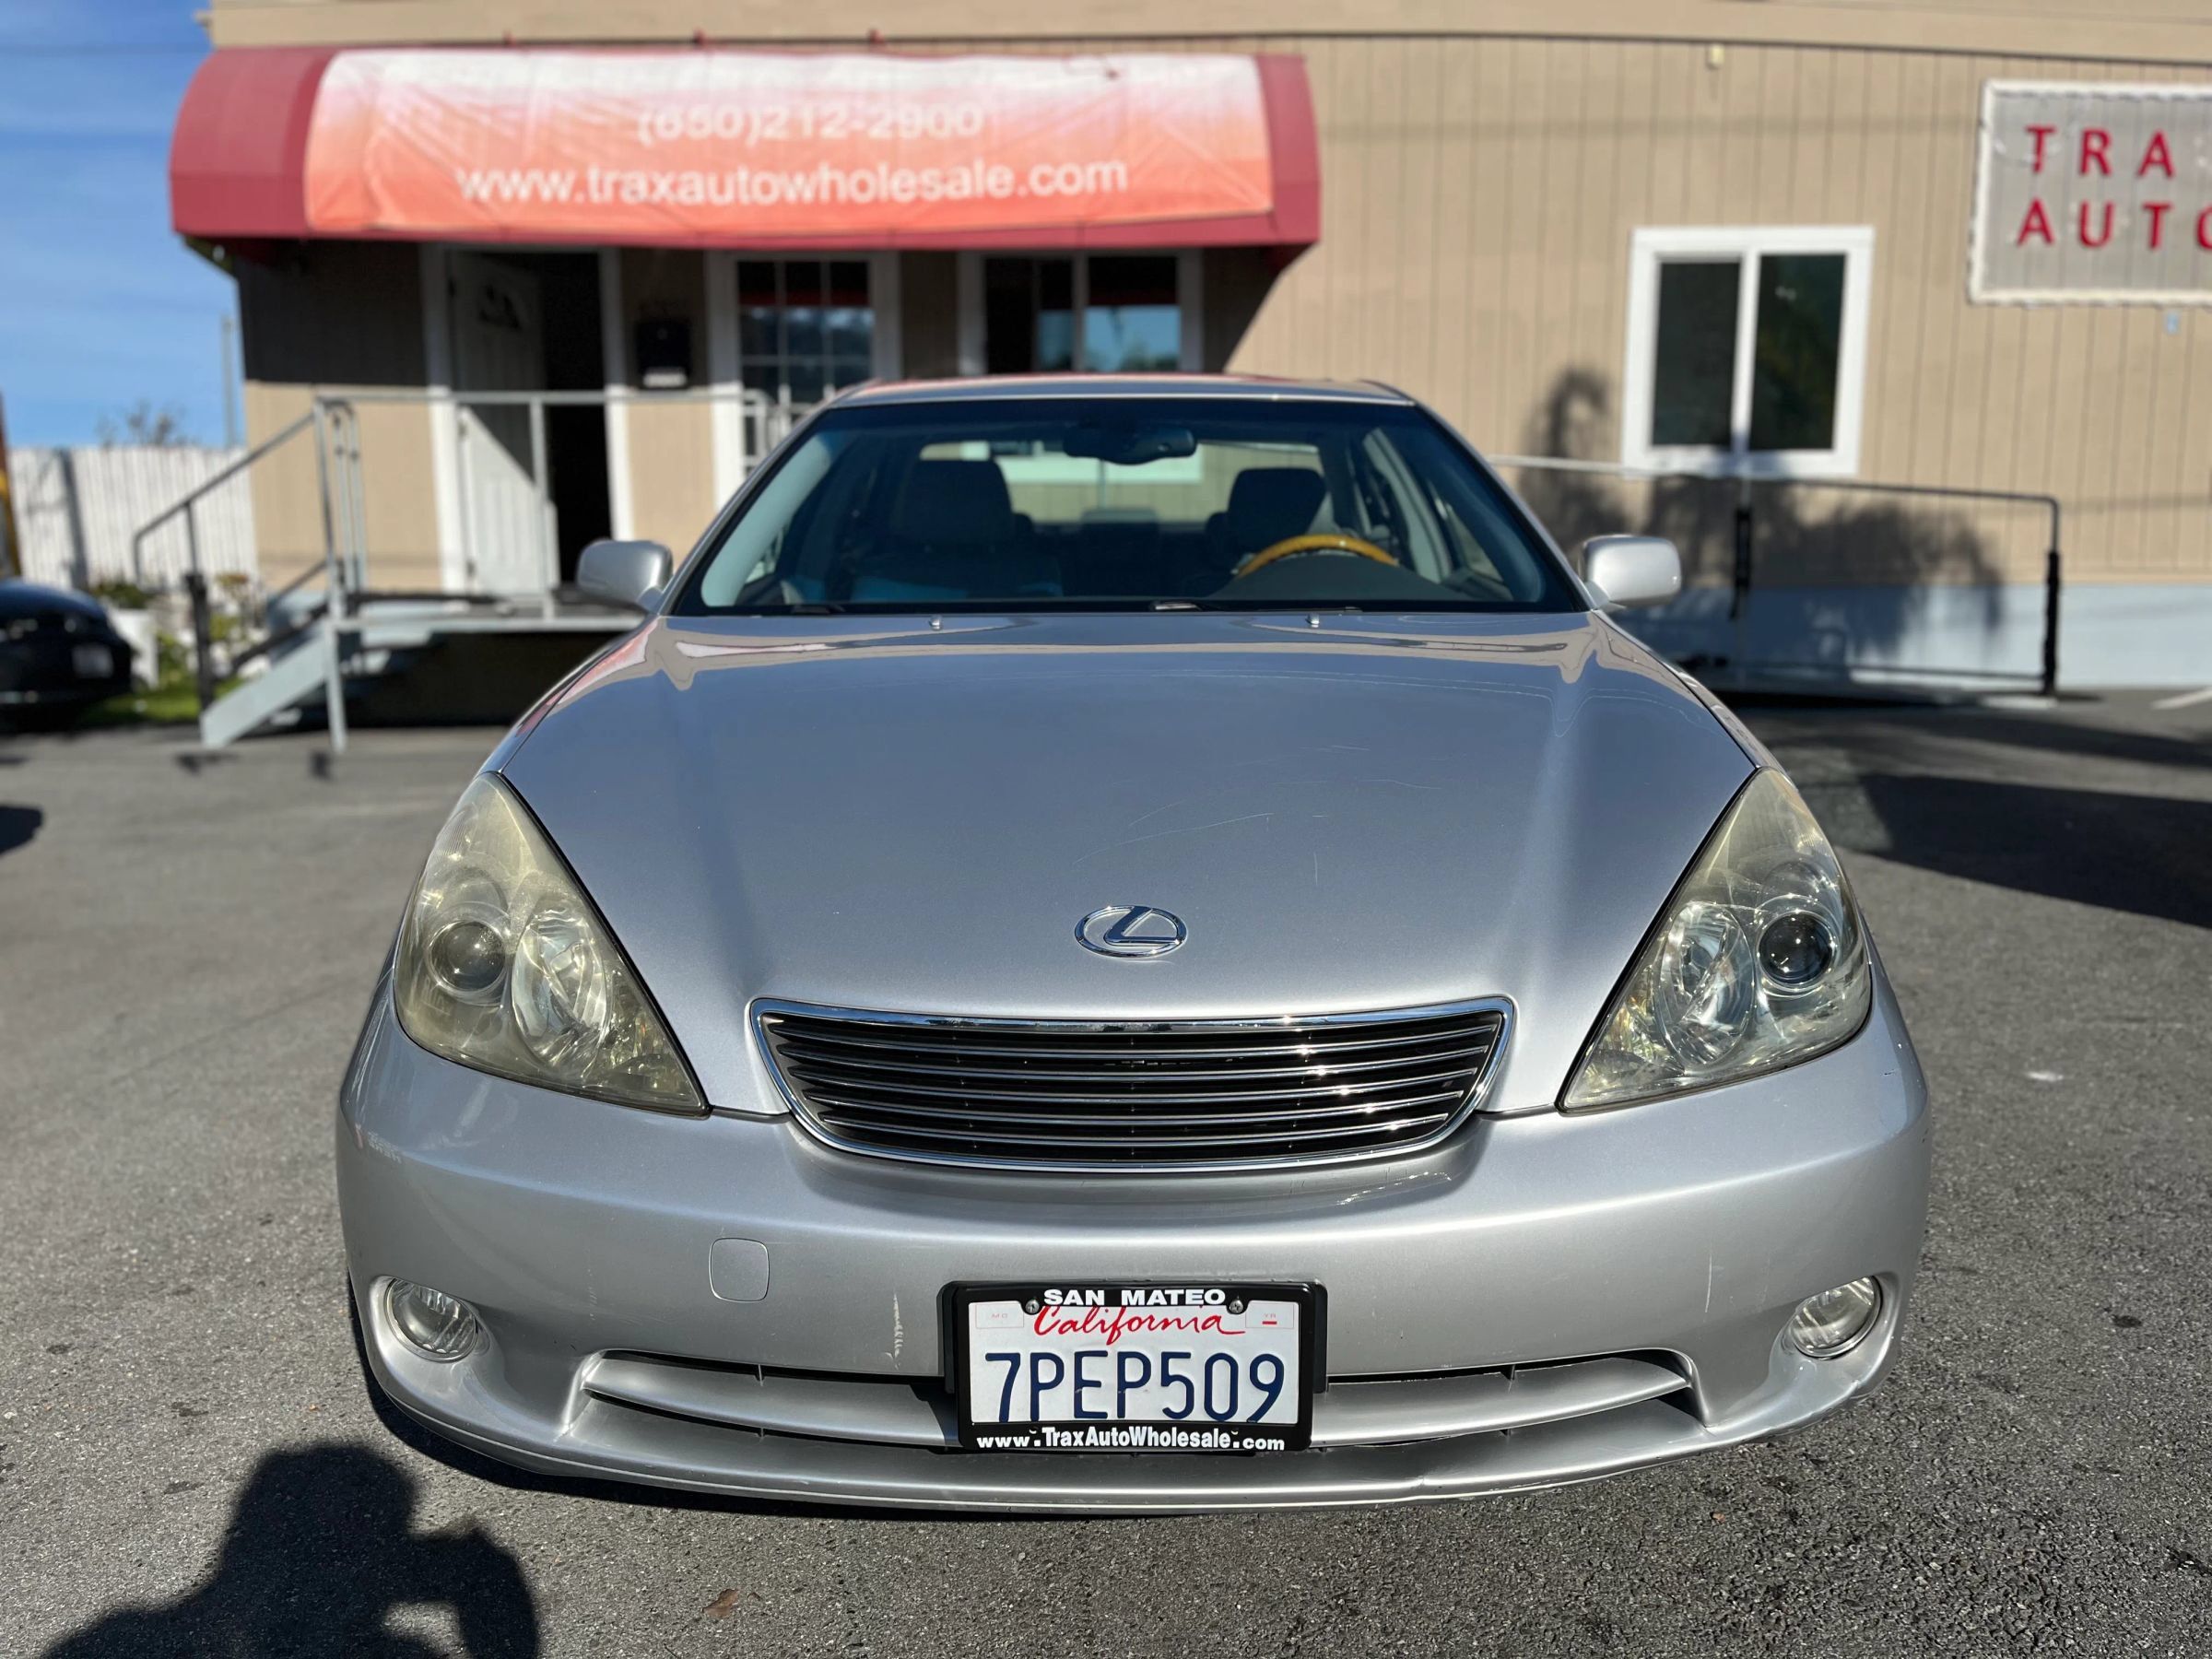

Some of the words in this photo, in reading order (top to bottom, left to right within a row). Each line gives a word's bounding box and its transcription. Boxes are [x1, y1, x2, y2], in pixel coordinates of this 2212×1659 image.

[455, 158, 1128, 206] www.traxautowholesale.com
[1043, 1288, 1105, 1306] SAN
[1121, 1288, 1226, 1306] MATEO
[1033, 1305, 1246, 1346] California
[985, 1350, 1285, 1423] 7PEP509
[976, 1426, 1285, 1451] www.TraxAutoWholesale.com
